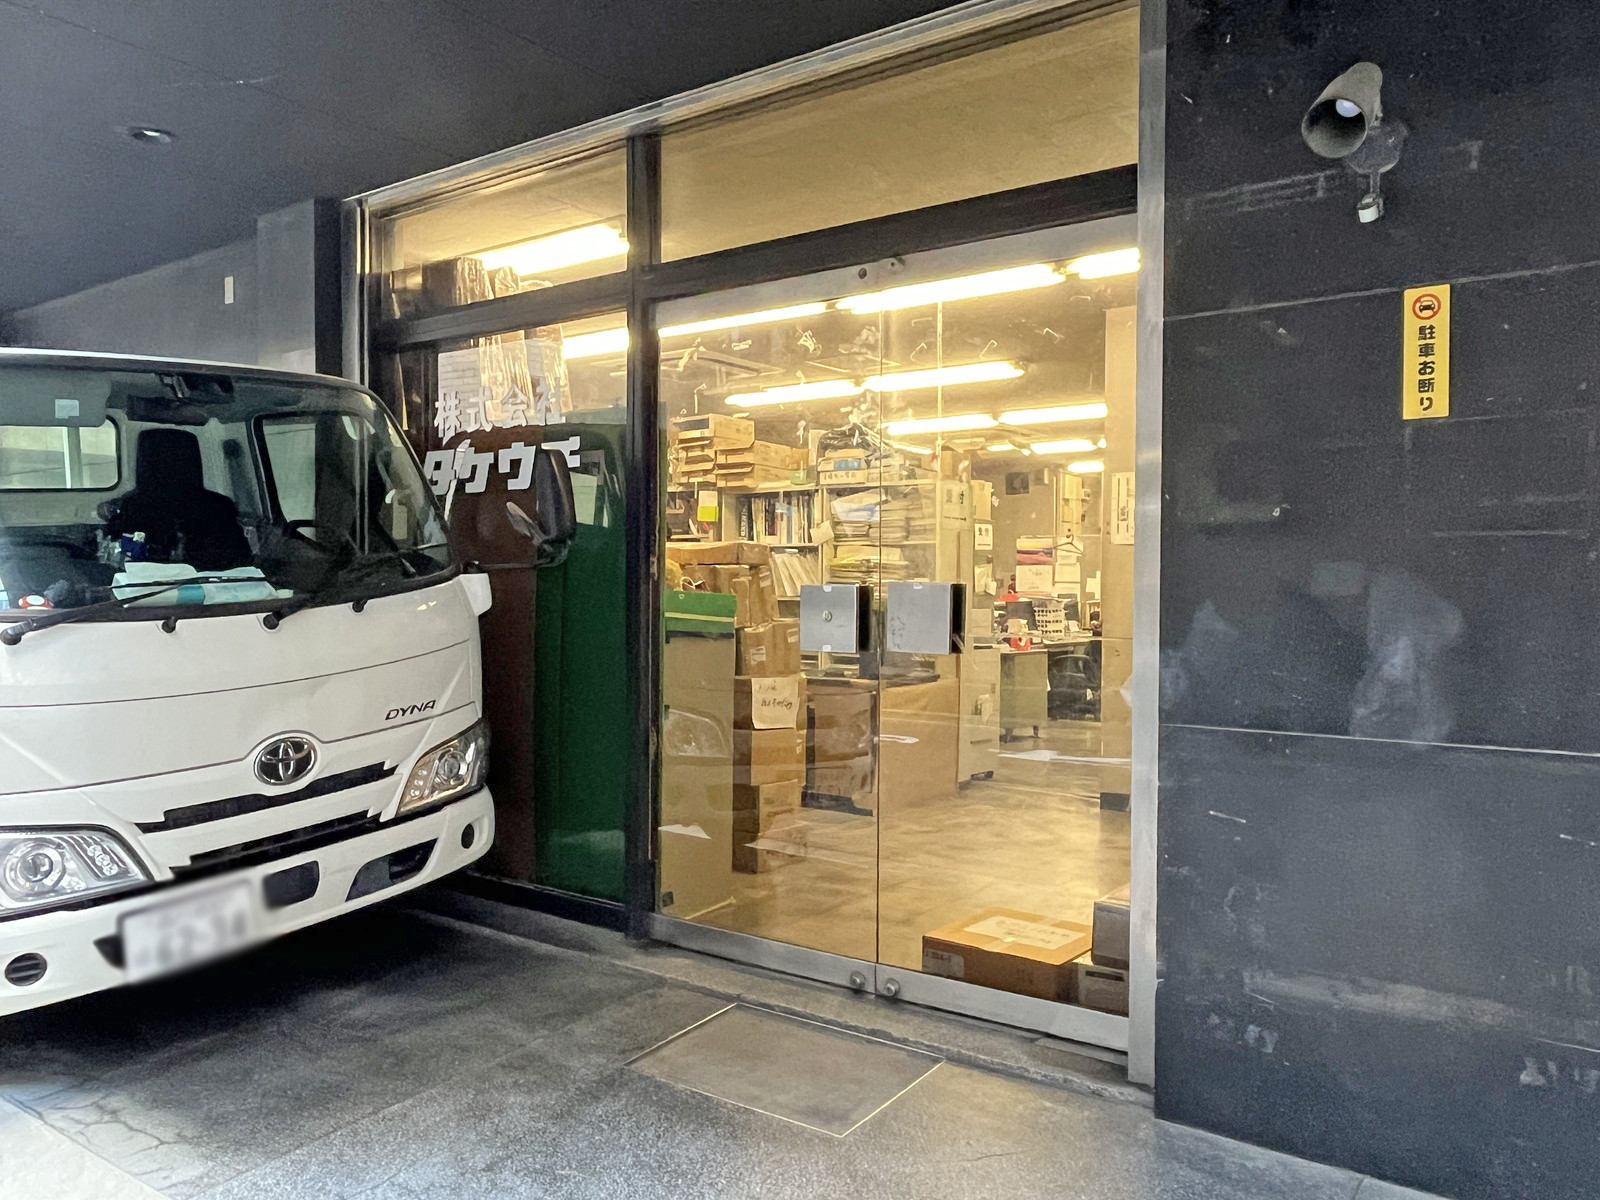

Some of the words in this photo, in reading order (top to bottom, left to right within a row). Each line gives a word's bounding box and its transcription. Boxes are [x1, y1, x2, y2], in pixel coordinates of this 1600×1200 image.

[1418, 324, 1436, 412] 駐車お断り
[434, 376, 566, 447] 株式会社
[385, 699, 437, 721] DYNA
